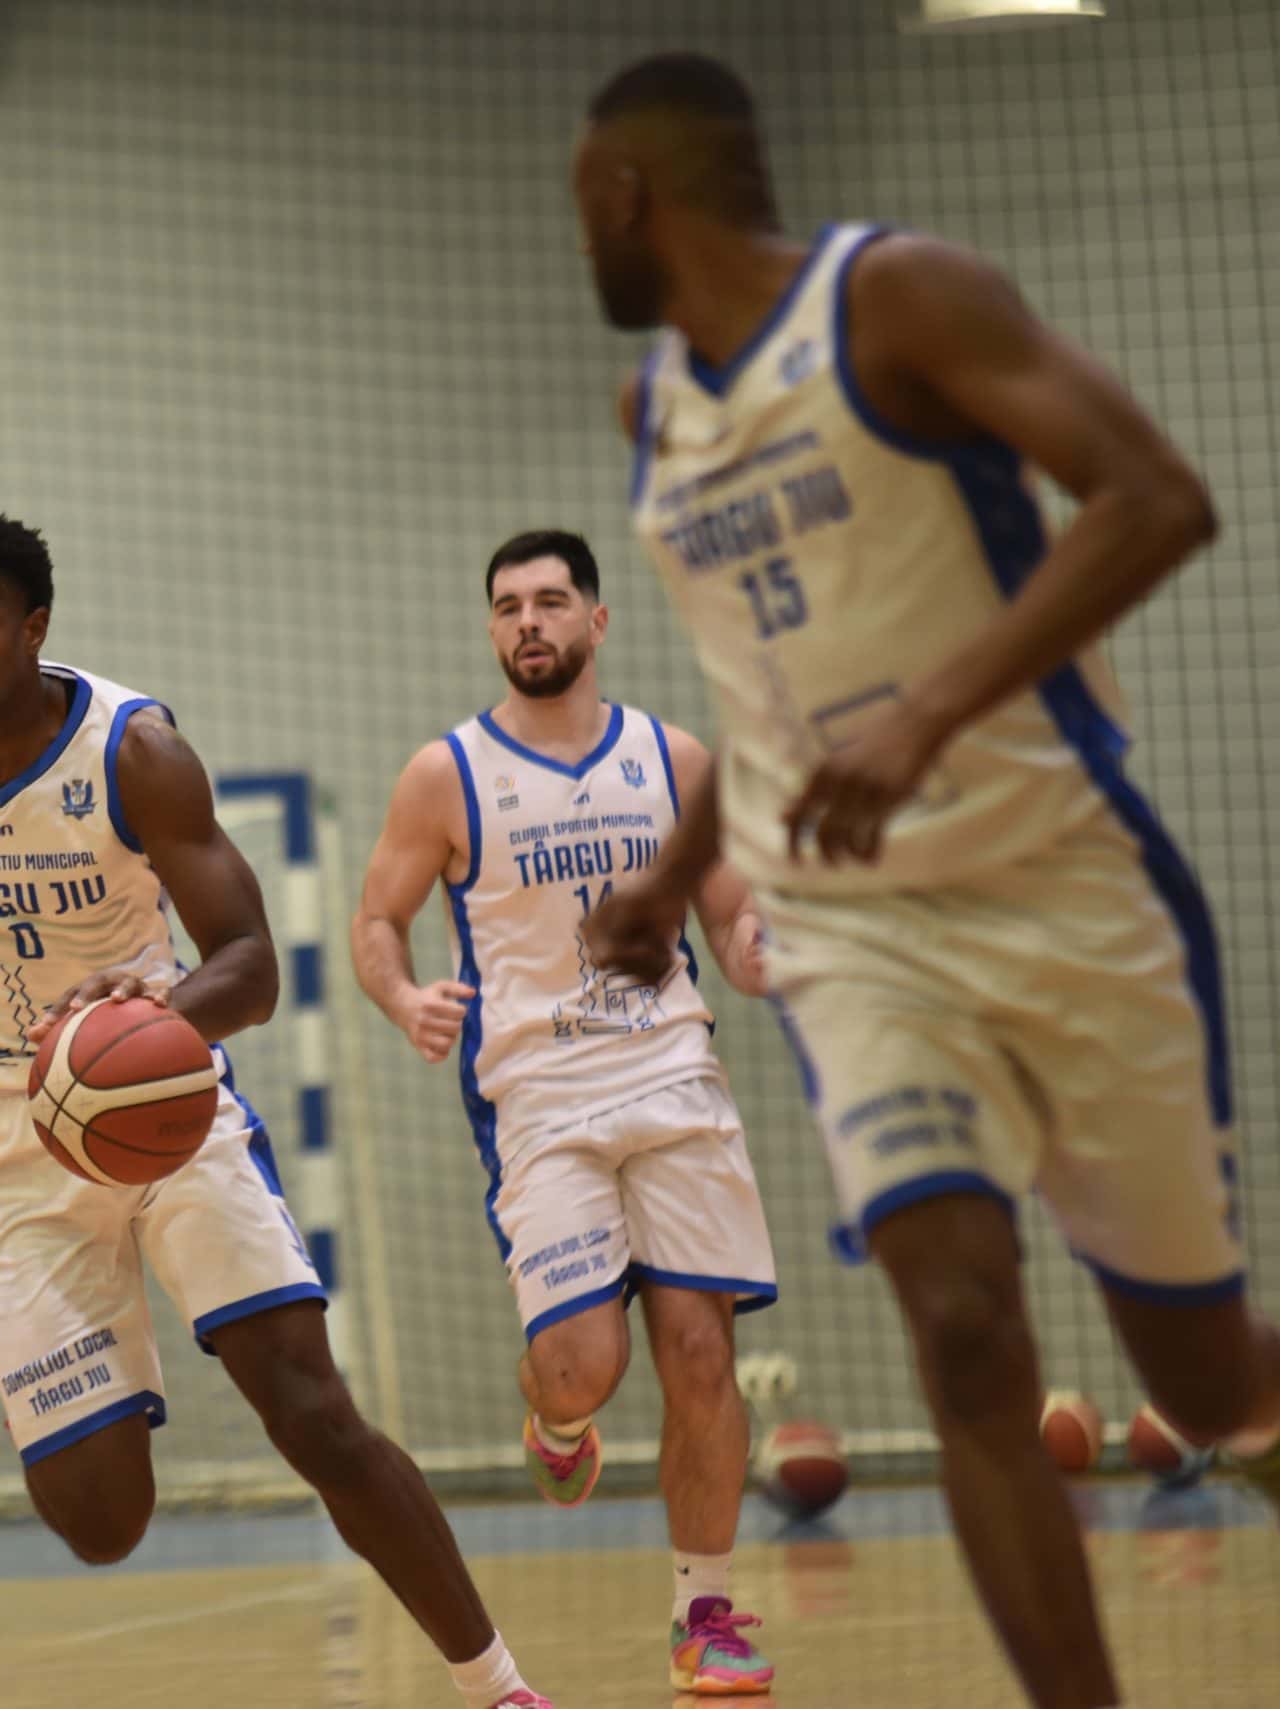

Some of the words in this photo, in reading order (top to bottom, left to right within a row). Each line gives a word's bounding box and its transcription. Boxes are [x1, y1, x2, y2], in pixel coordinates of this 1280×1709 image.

[740, 556, 810, 640] 15
[509, 824, 551, 845] CLUBUL
[25, 851, 98, 871] MUNICIPAL
[514, 839, 613, 888] TÂRGU
[49, 874, 107, 915] JIU
[84, 1362, 111, 1390] JIU
